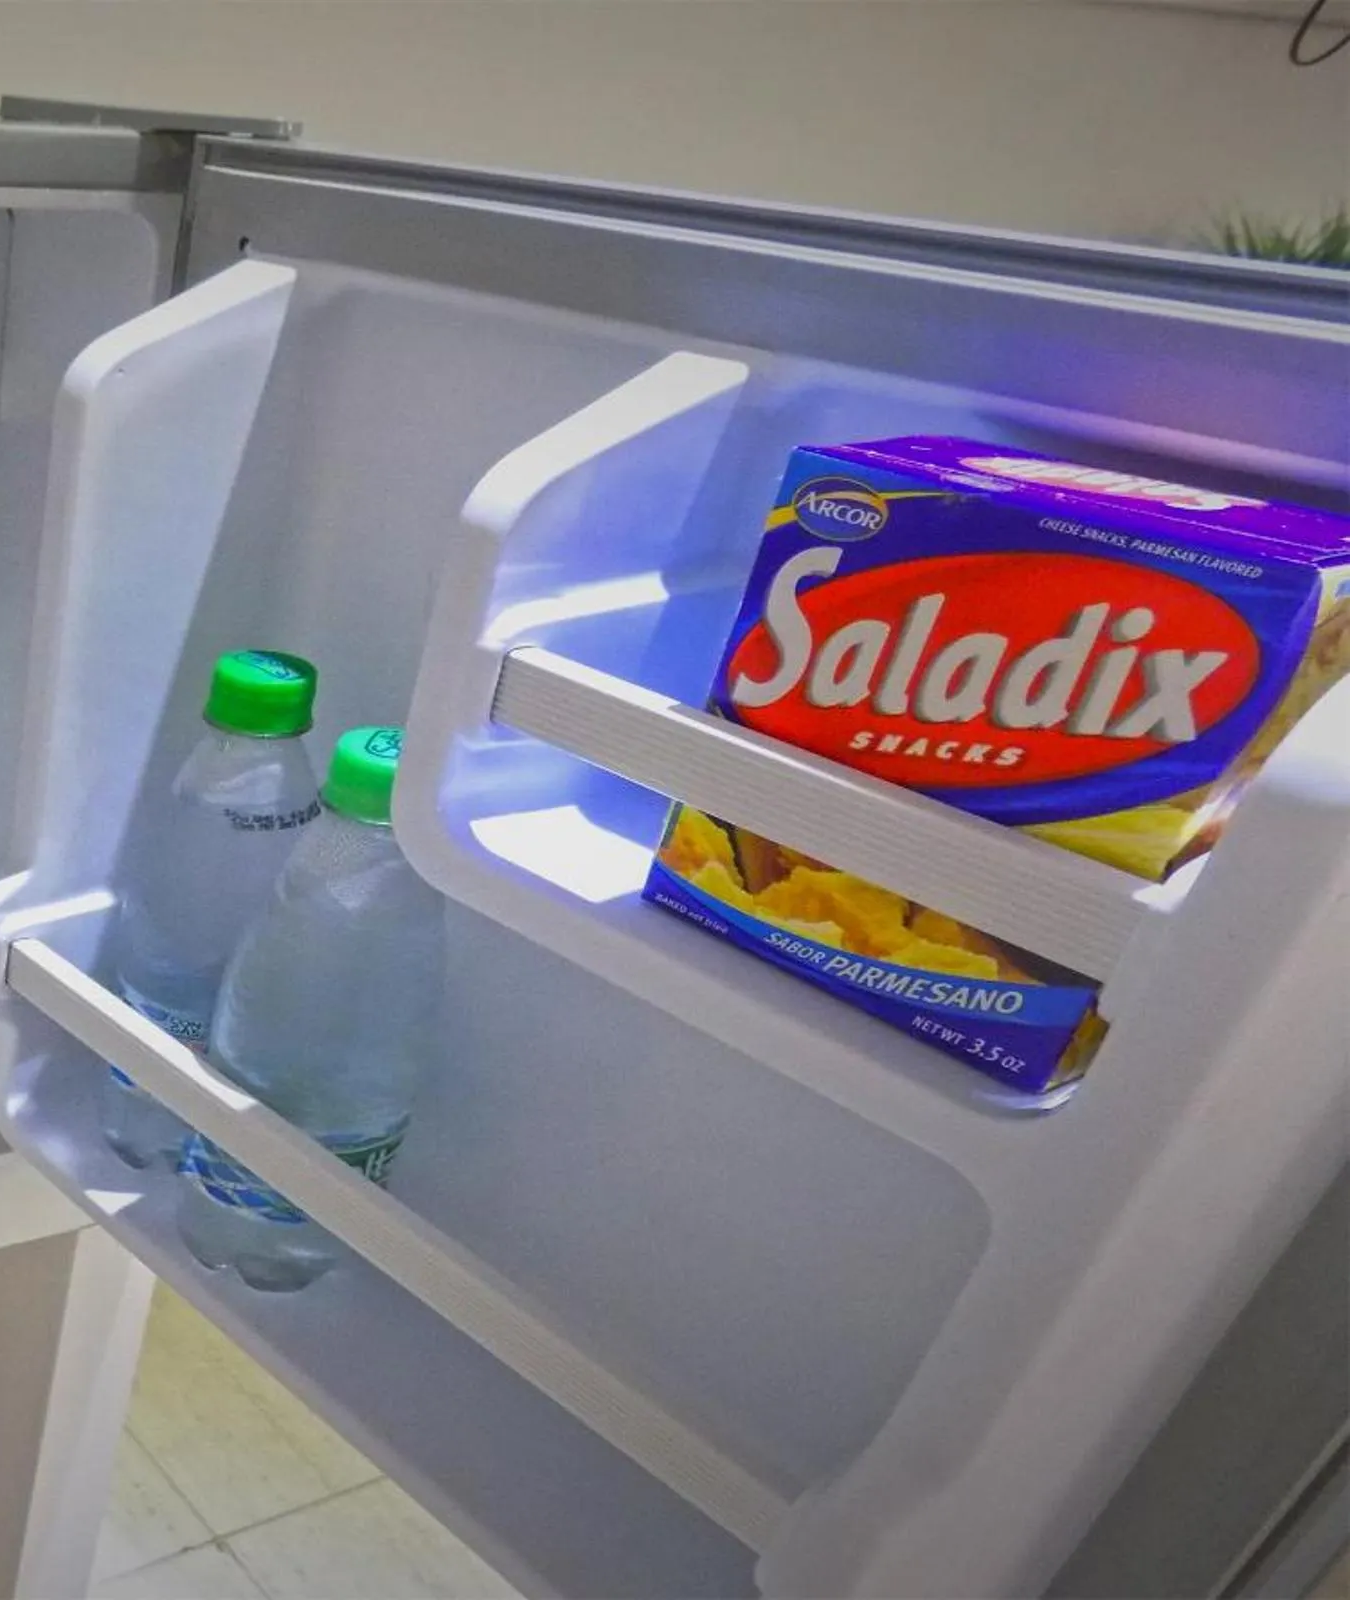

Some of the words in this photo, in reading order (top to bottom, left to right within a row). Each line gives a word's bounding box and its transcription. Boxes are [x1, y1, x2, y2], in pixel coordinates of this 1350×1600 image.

[797, 491, 881, 530] ARCOR
[1038, 516, 1084, 537] CHEESE
[1129, 536, 1202, 564] PARMESAN
[1198, 554, 1264, 579] FLAVORED
[731, 546, 1230, 743] Saladix
[849, 730, 1025, 768] SNACKS
[763, 931, 826, 964] SABOR
[822, 956, 1024, 1015] PARMESANO
[964, 1037, 1005, 1062] 3.5
